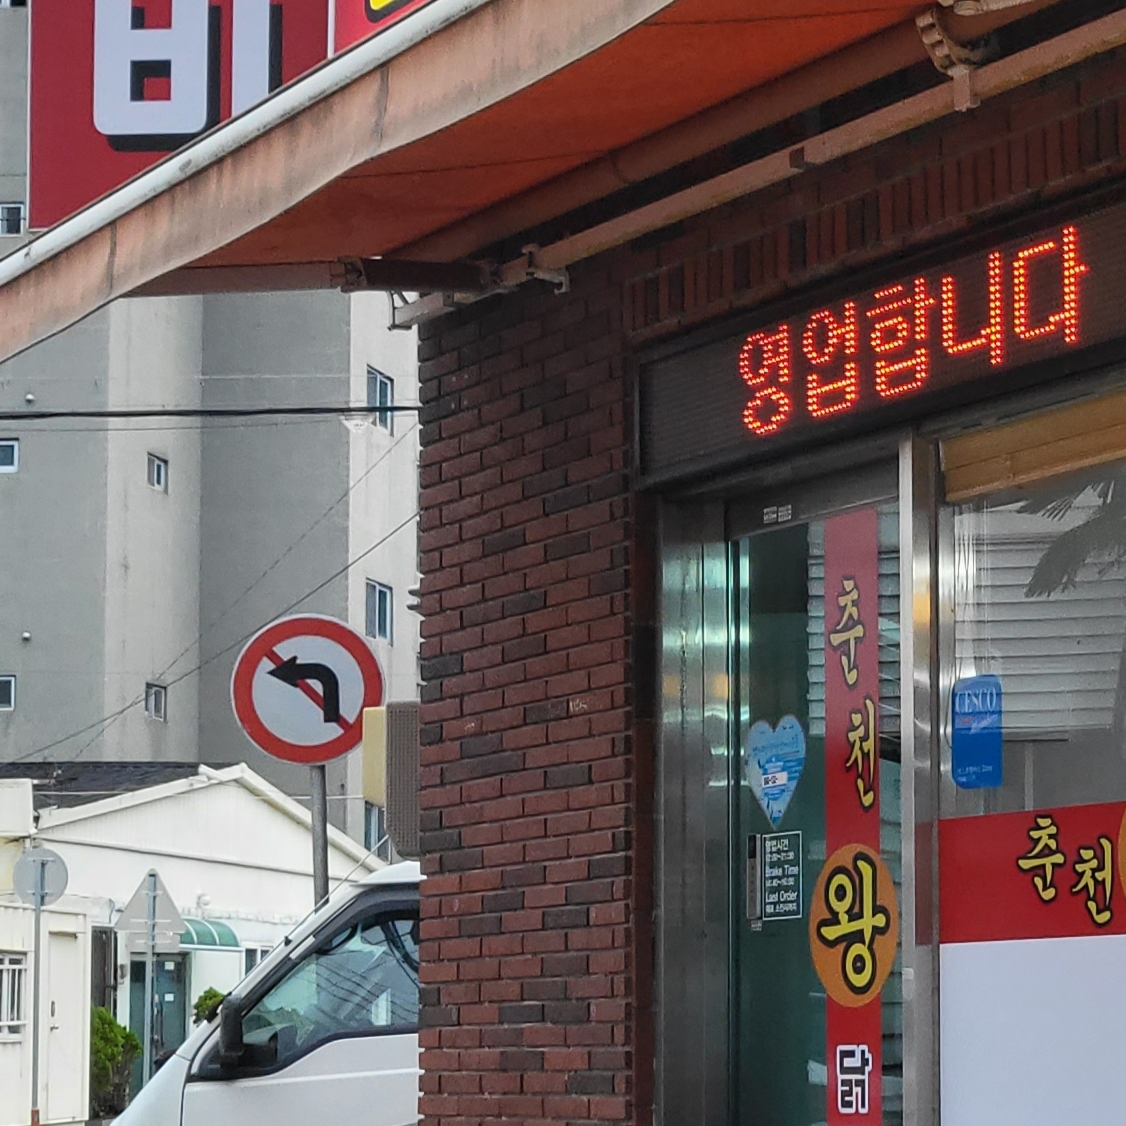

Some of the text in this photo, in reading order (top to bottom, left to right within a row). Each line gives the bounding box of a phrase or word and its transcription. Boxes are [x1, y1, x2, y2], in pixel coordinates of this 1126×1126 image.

[739, 226, 1089, 434] 영업합니다
[955, 686, 997, 714] CESCO
[765, 890, 798, 902] Last Order
